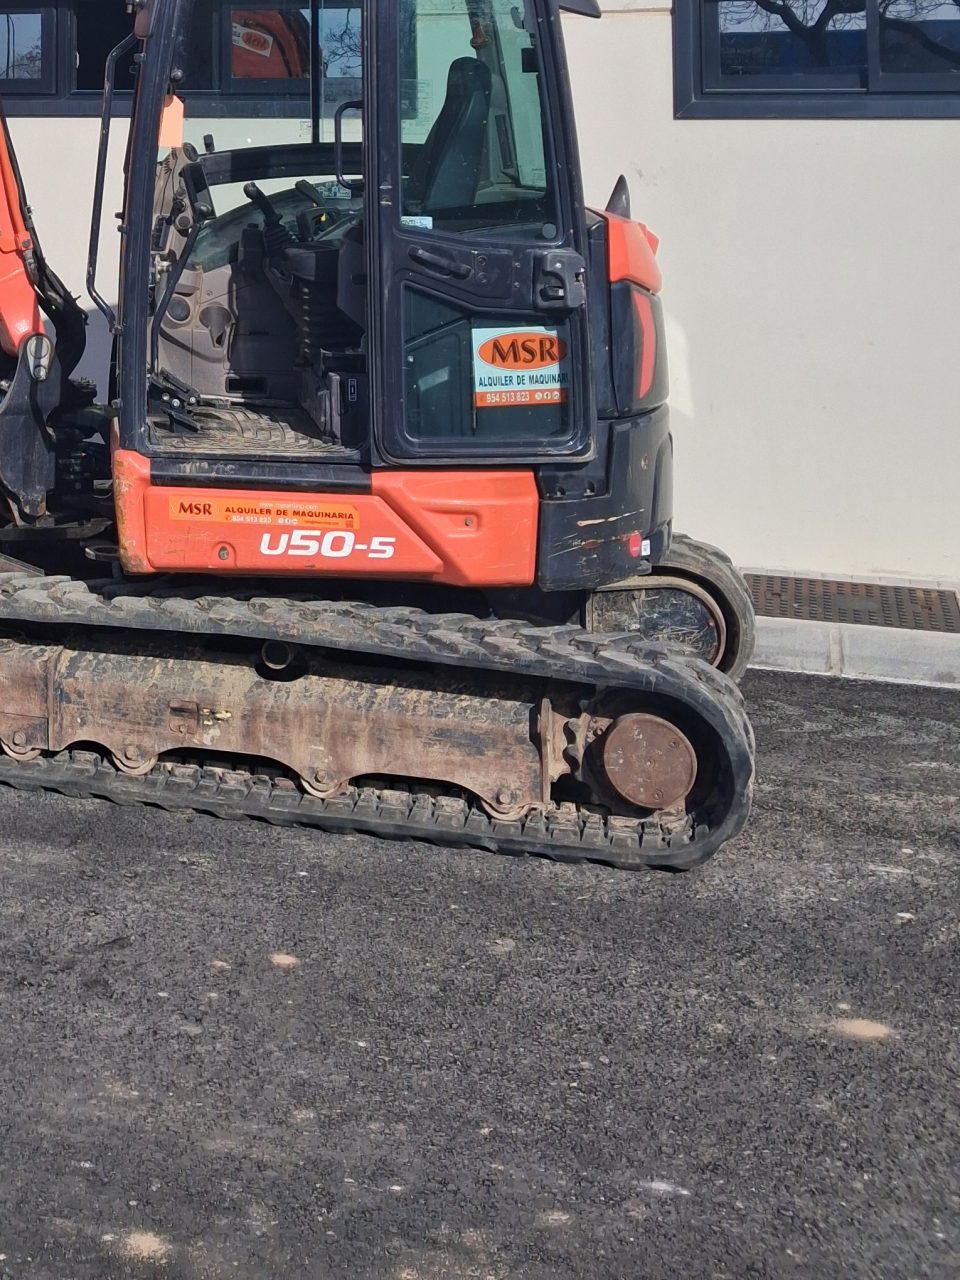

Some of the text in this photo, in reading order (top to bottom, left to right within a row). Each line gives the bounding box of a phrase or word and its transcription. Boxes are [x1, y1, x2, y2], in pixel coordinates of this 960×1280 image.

[491, 337, 559, 364] MSR
[479, 375, 514, 387] ALQUILER
[516, 375, 526, 386] DE
[486, 391, 530, 403] 954 513 823
[178, 502, 212, 515] MSR
[225, 506, 272, 515] ALQUILER
[292, 510, 354, 520] MAQUINARIA
